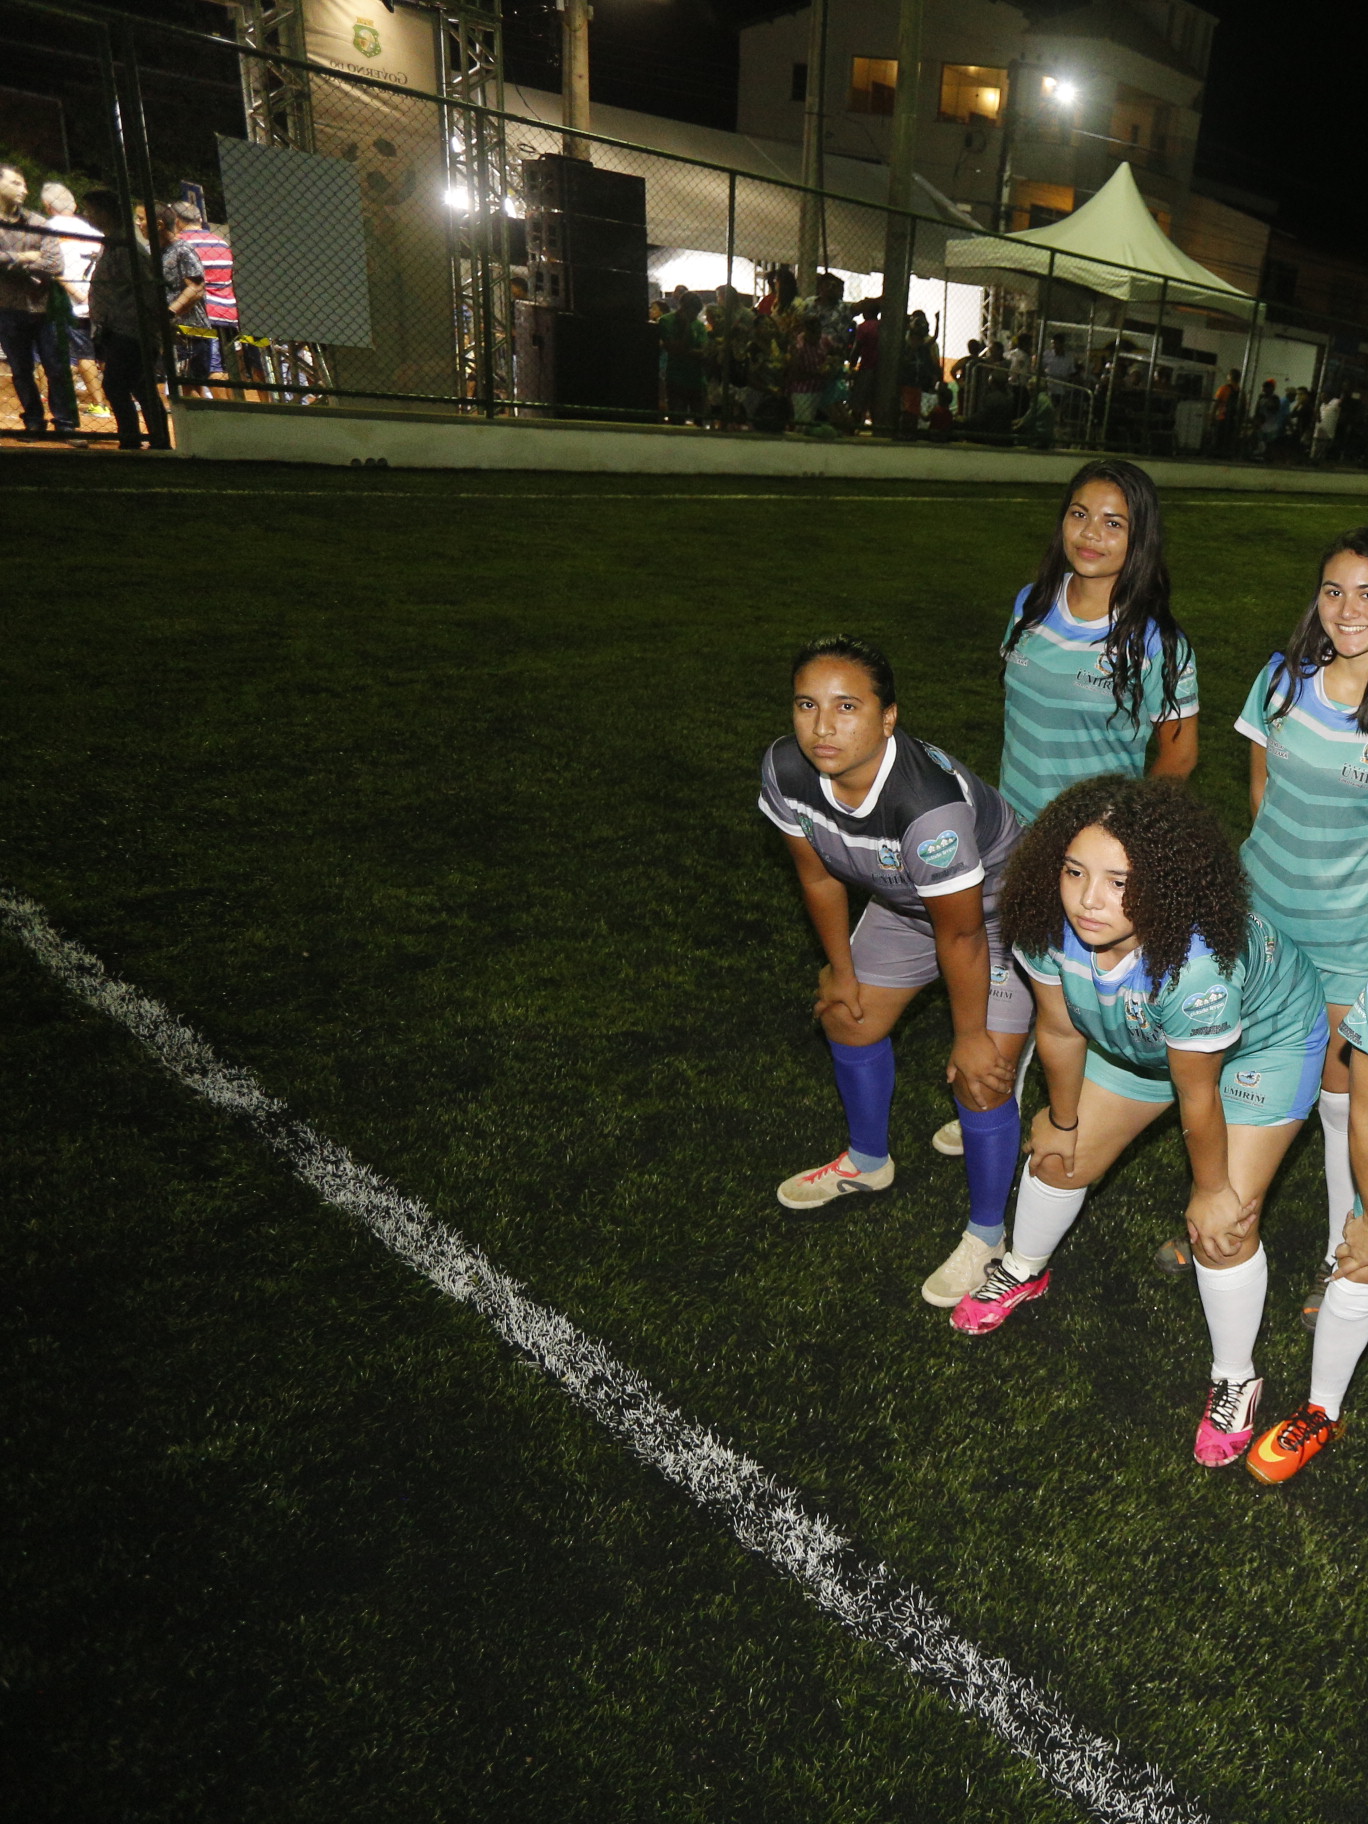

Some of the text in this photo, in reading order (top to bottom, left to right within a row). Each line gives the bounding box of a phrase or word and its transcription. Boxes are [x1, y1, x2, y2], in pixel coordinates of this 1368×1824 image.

[1076, 670, 1112, 691] UMIR
[989, 989, 1013, 999] IRIM
[1223, 1086, 1265, 1104] UMIRIM
